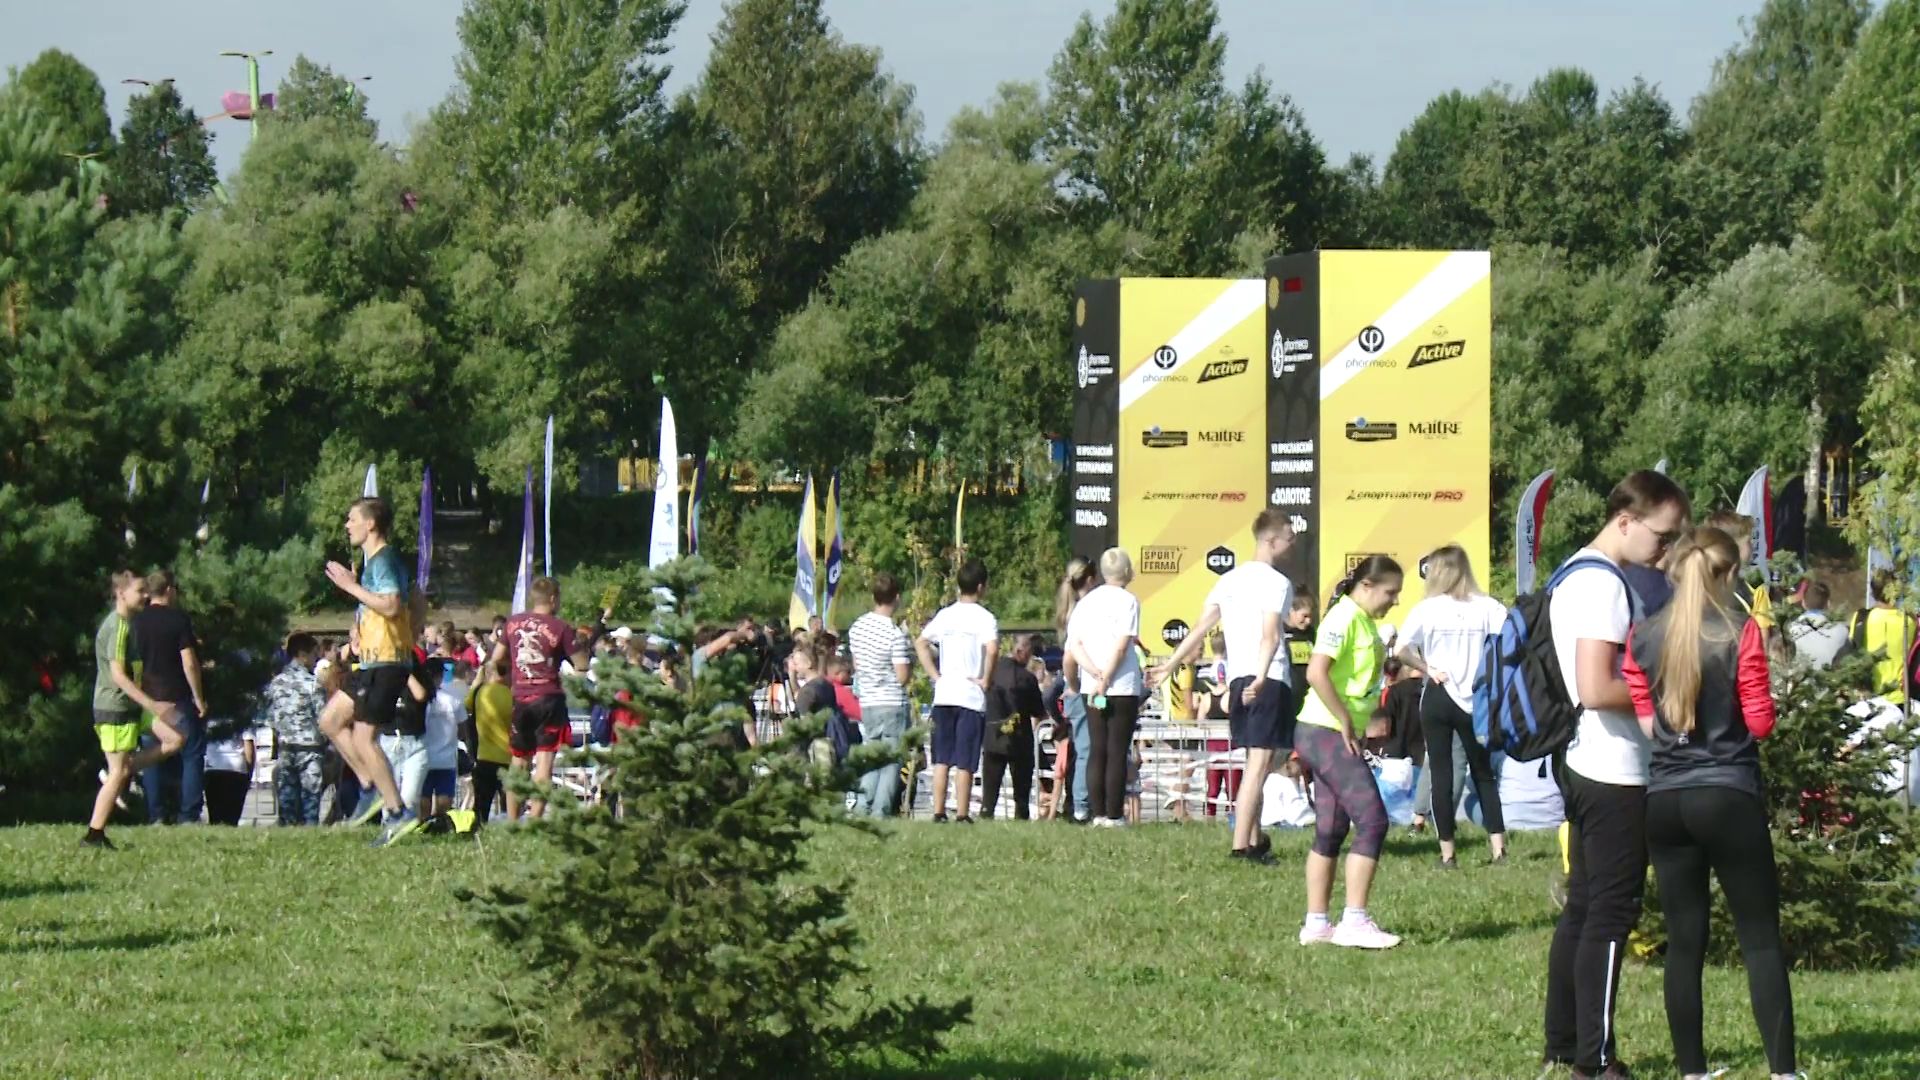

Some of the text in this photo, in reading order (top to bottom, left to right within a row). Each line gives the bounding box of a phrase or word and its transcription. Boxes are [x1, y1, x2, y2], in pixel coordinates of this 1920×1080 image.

[1417, 344, 1461, 362] Active
[1205, 362, 1245, 377] Active
[1220, 492, 1247, 502] PRO
[1434, 491, 1464, 502] PRO
[1144, 551, 1175, 560] SPORT
[1208, 555, 1233, 566] GU
[1144, 562, 1176, 570] FERMA
